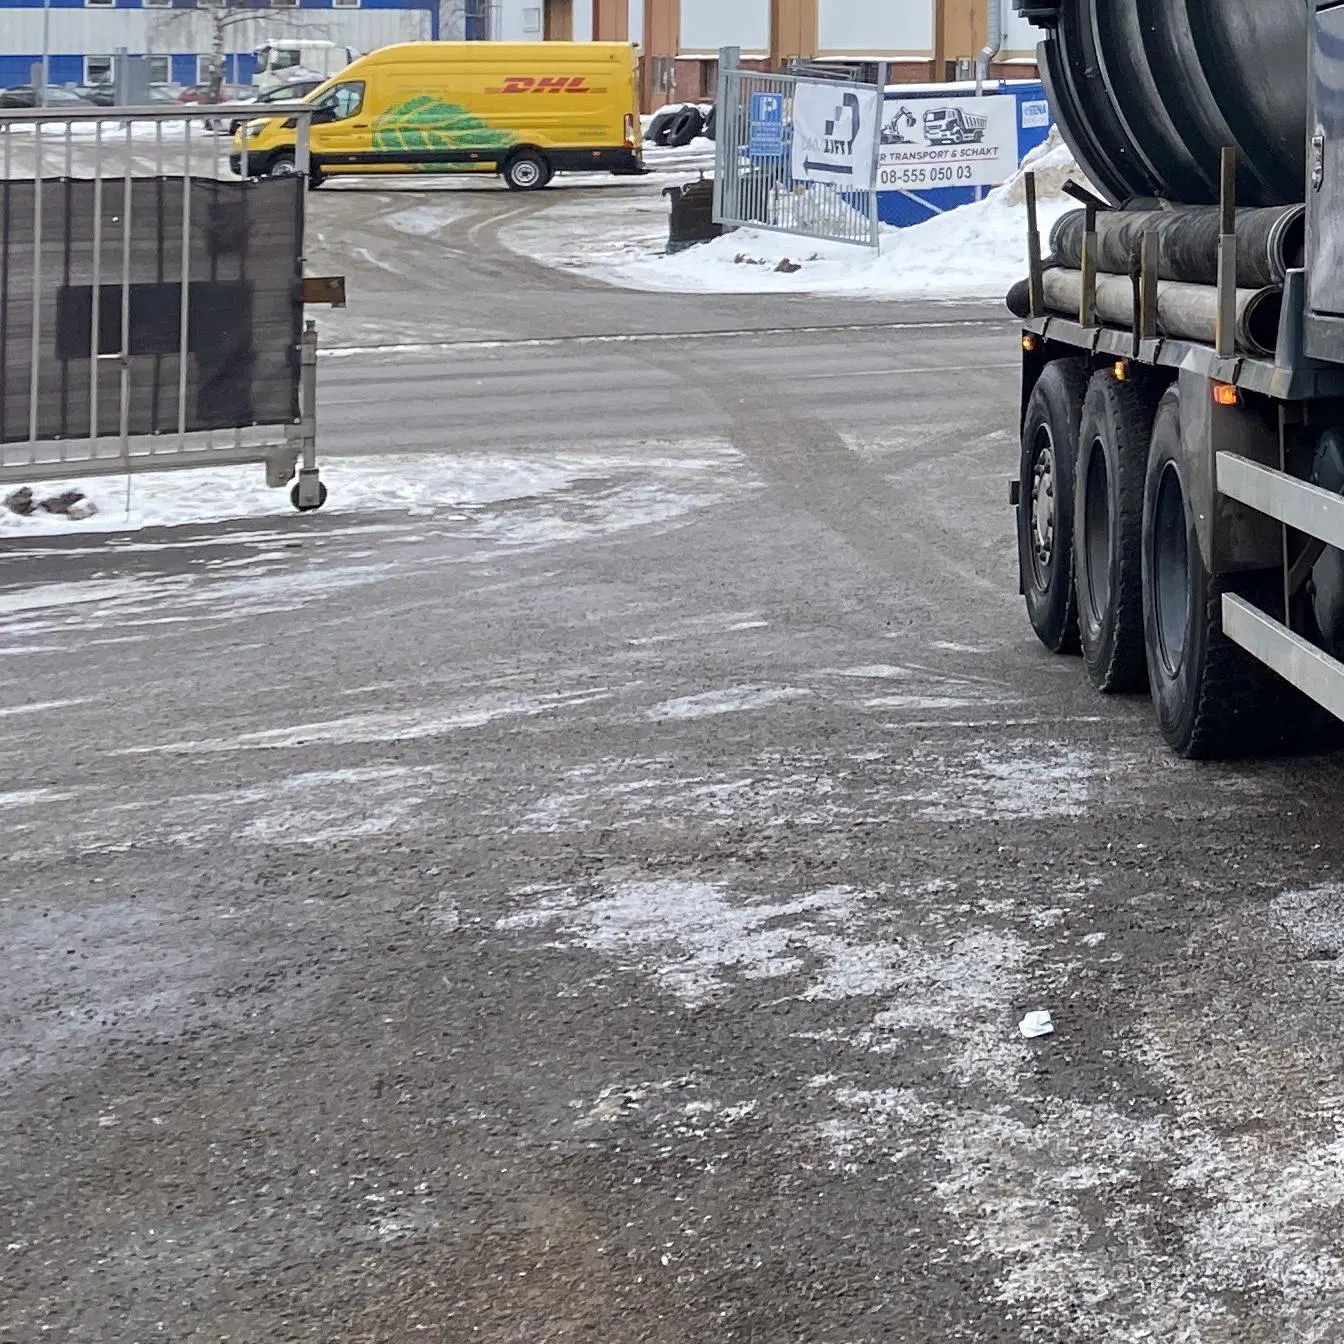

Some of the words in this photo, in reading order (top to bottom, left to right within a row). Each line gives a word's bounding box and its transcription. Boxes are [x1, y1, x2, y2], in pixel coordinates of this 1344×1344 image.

[501, 76, 591, 94] DHL
[889, 149, 950, 161] TRANSPORT
[960, 146, 999, 158] SCHAKT
[880, 167, 926, 185] 08-555
[930, 166, 953, 182] 050
[956, 165, 973, 180] 03
